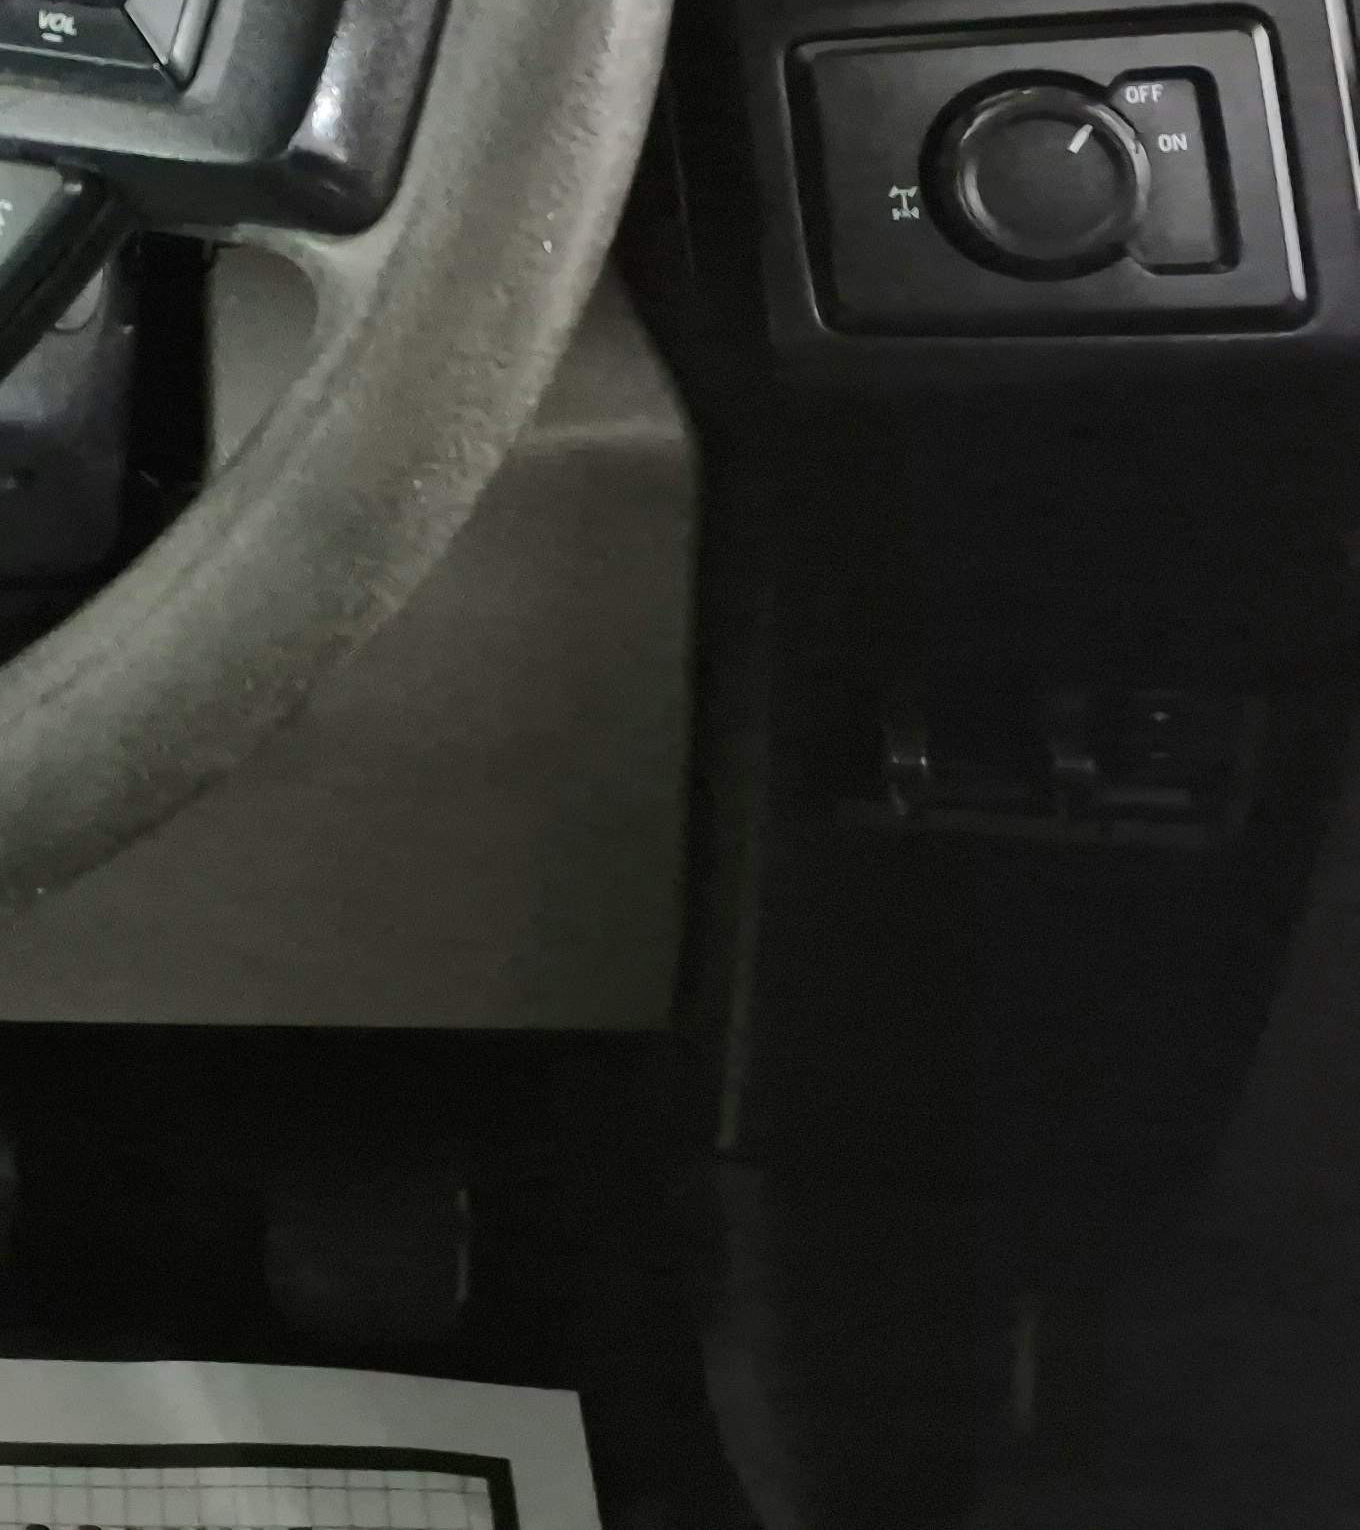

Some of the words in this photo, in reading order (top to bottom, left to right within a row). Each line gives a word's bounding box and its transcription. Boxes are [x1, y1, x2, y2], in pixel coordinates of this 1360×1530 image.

[37, 9, 78, 37] VOL
[1125, 83, 1164, 104] OFF
[1157, 133, 1189, 153] ON
